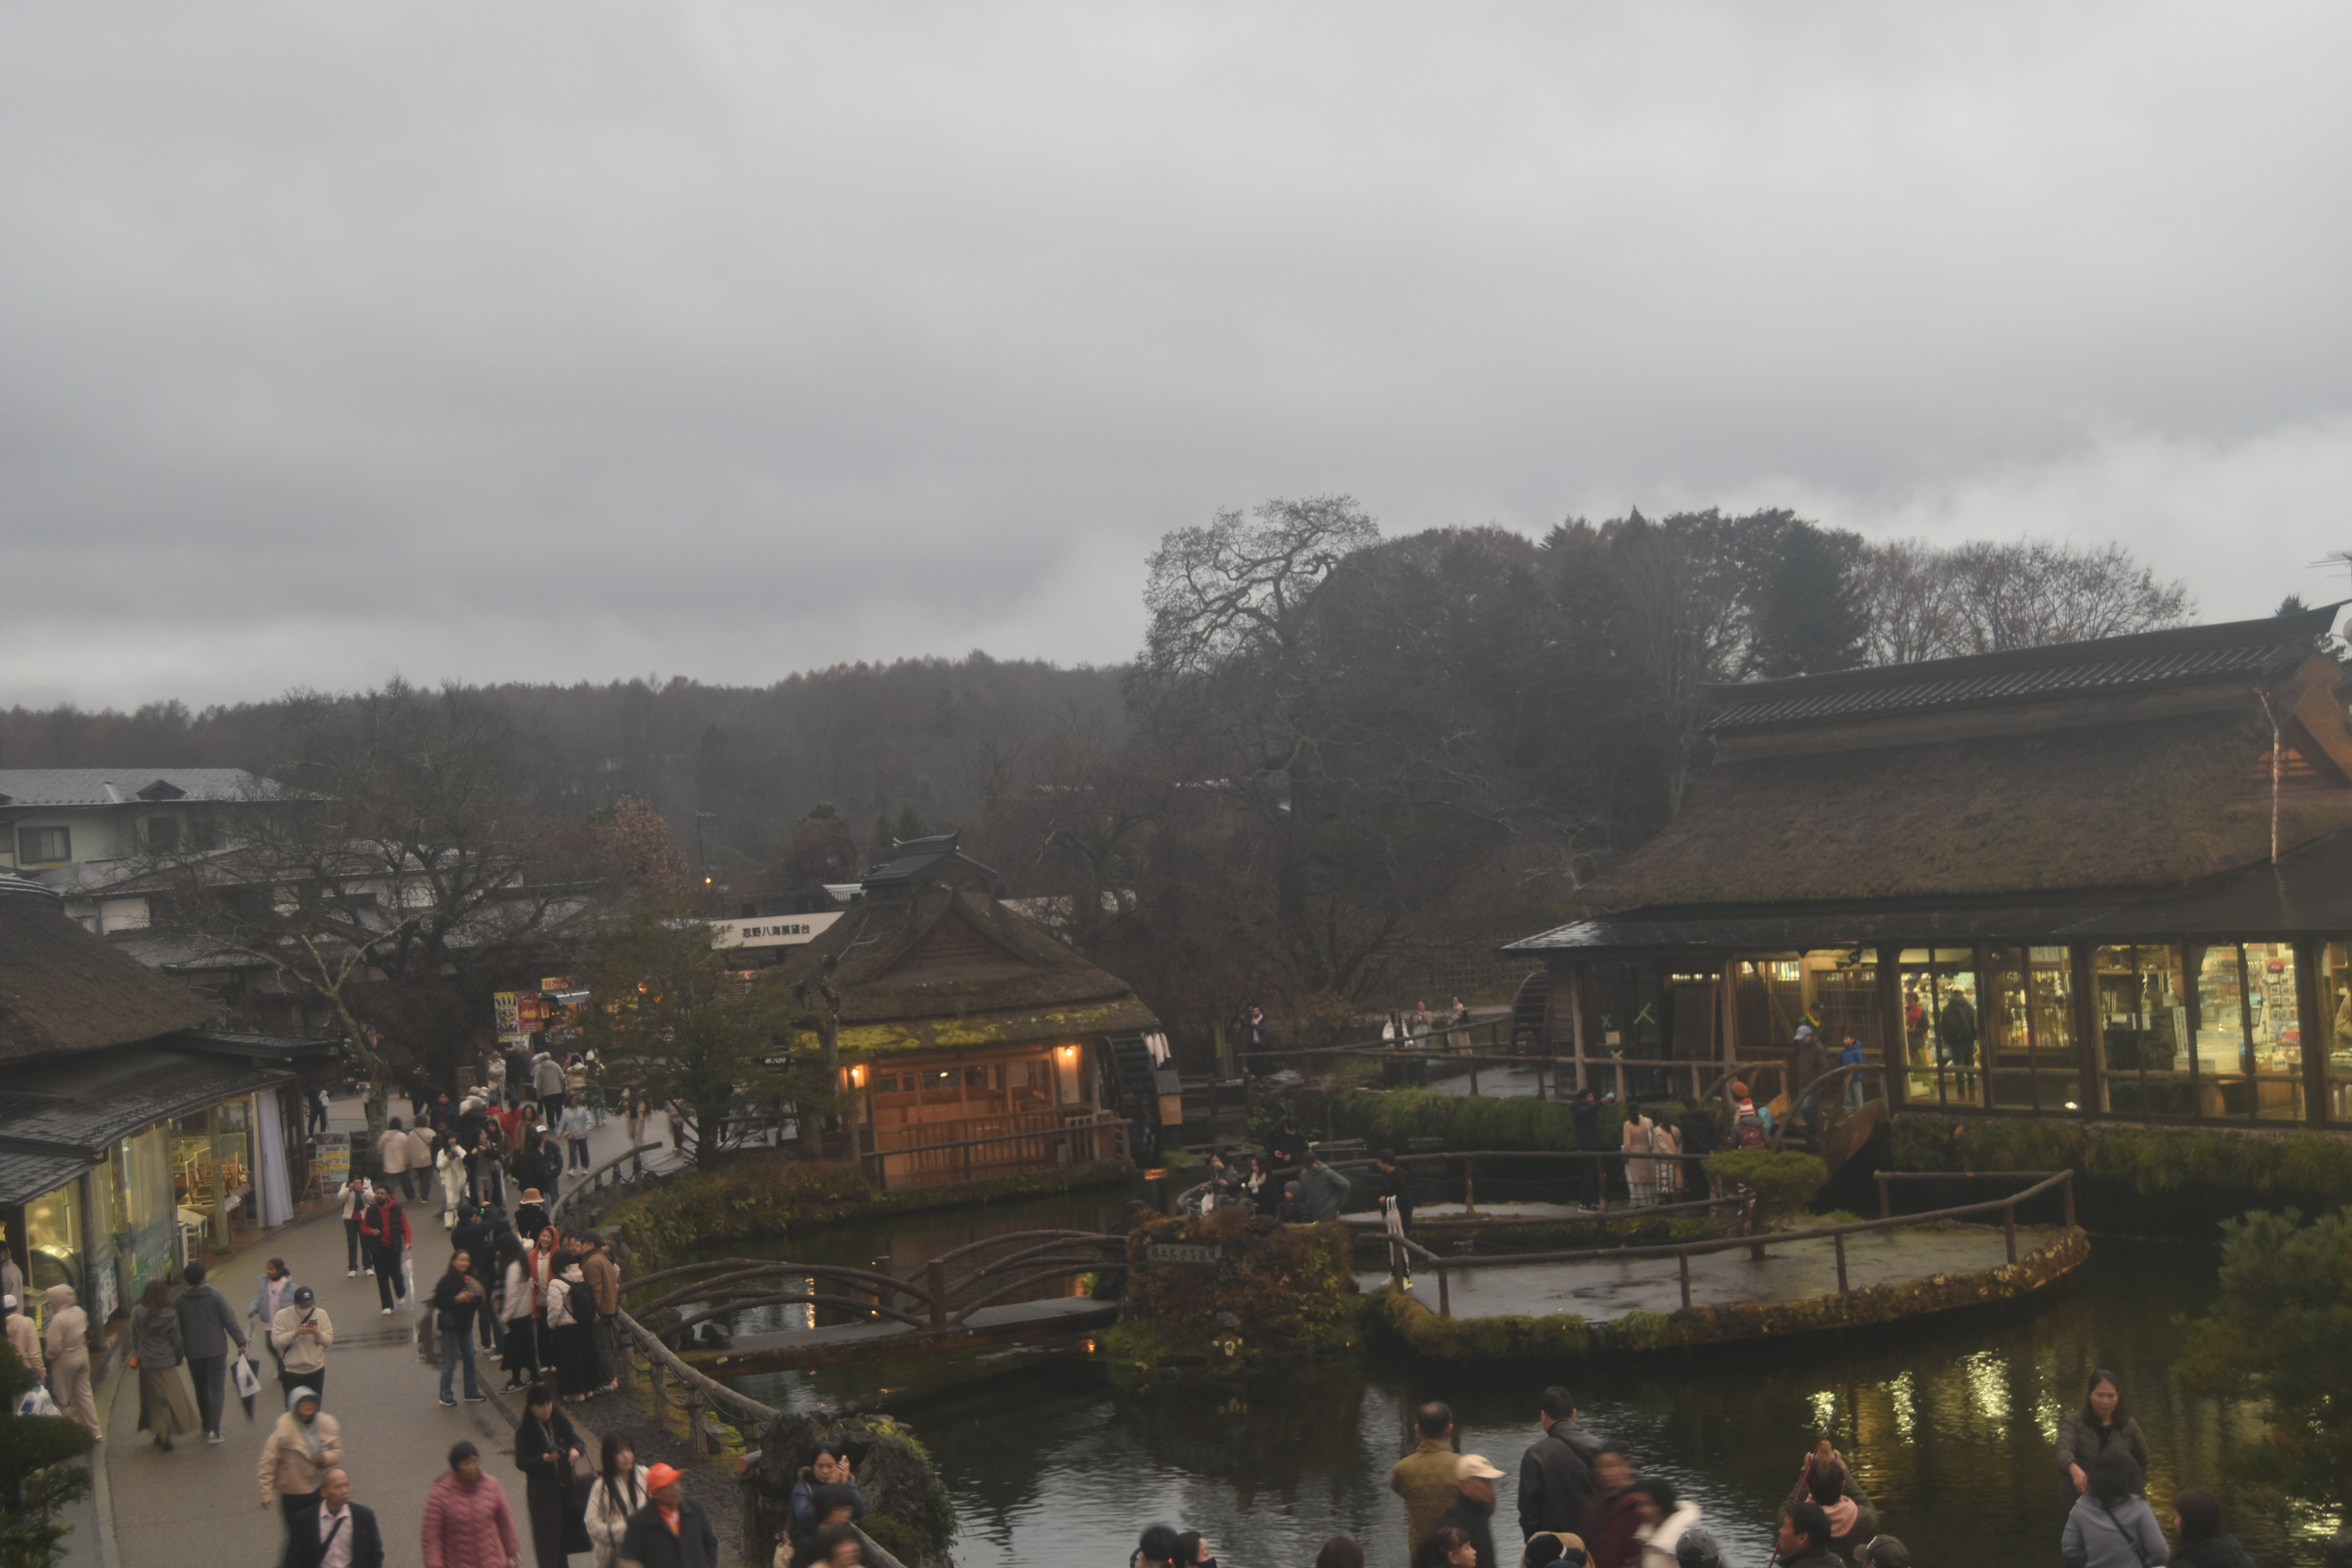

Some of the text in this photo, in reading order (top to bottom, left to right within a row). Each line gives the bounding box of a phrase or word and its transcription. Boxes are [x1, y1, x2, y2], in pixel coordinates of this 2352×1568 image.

[742, 923, 809, 938] 忍野八海展望台
